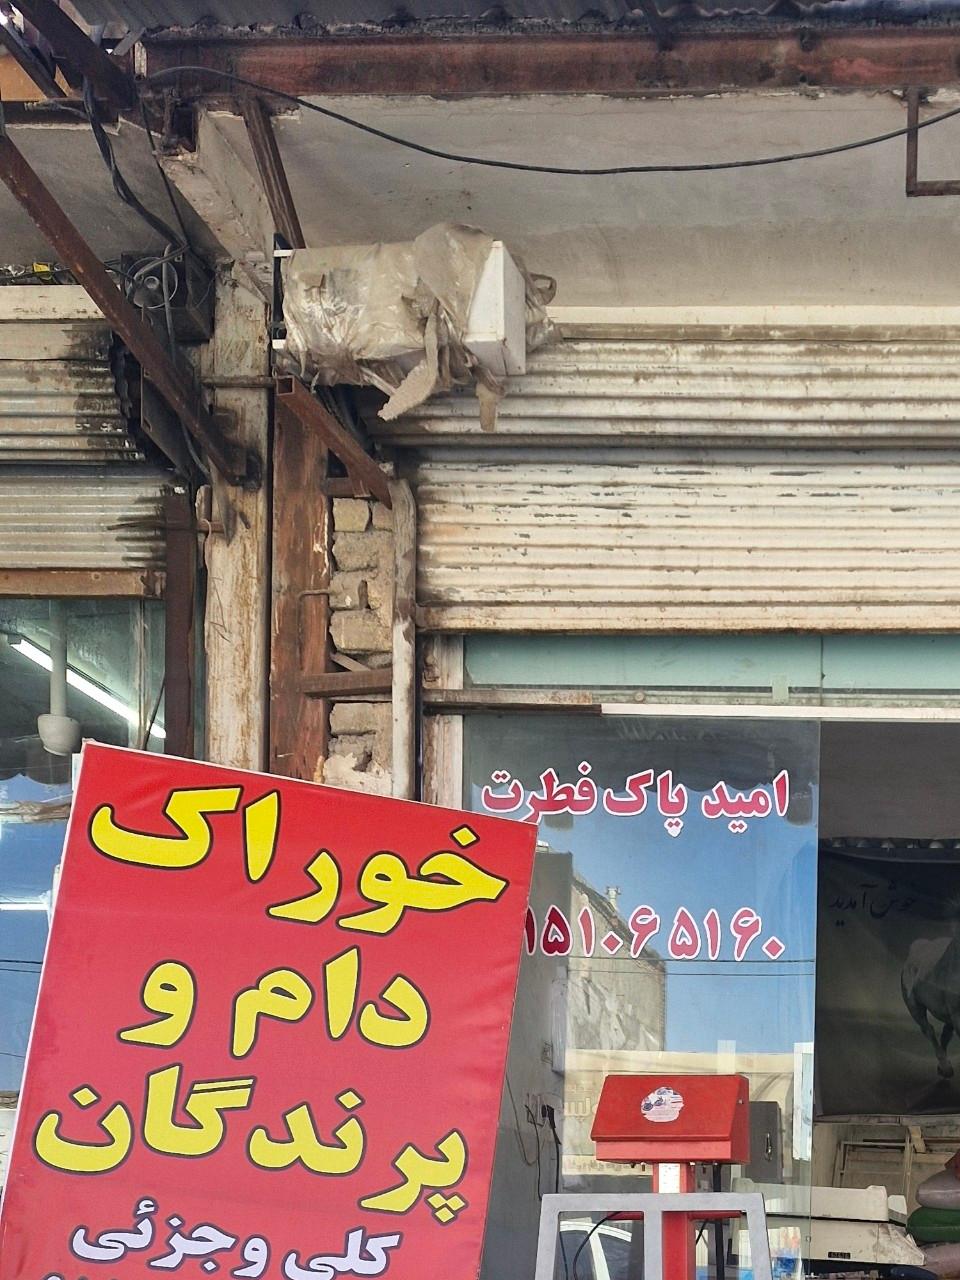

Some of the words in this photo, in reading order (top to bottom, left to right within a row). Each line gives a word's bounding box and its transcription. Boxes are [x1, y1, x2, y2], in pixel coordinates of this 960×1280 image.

[481, 761, 598, 825] فطرت
[603, 769, 688, 837] پاک
[701, 769, 790, 833] امید
[89, 787, 509, 934] خوراک
[118, 960, 197, 1048] و
[232, 945, 429, 1058] دام
[33, 1063, 468, 1224] پرندگان
